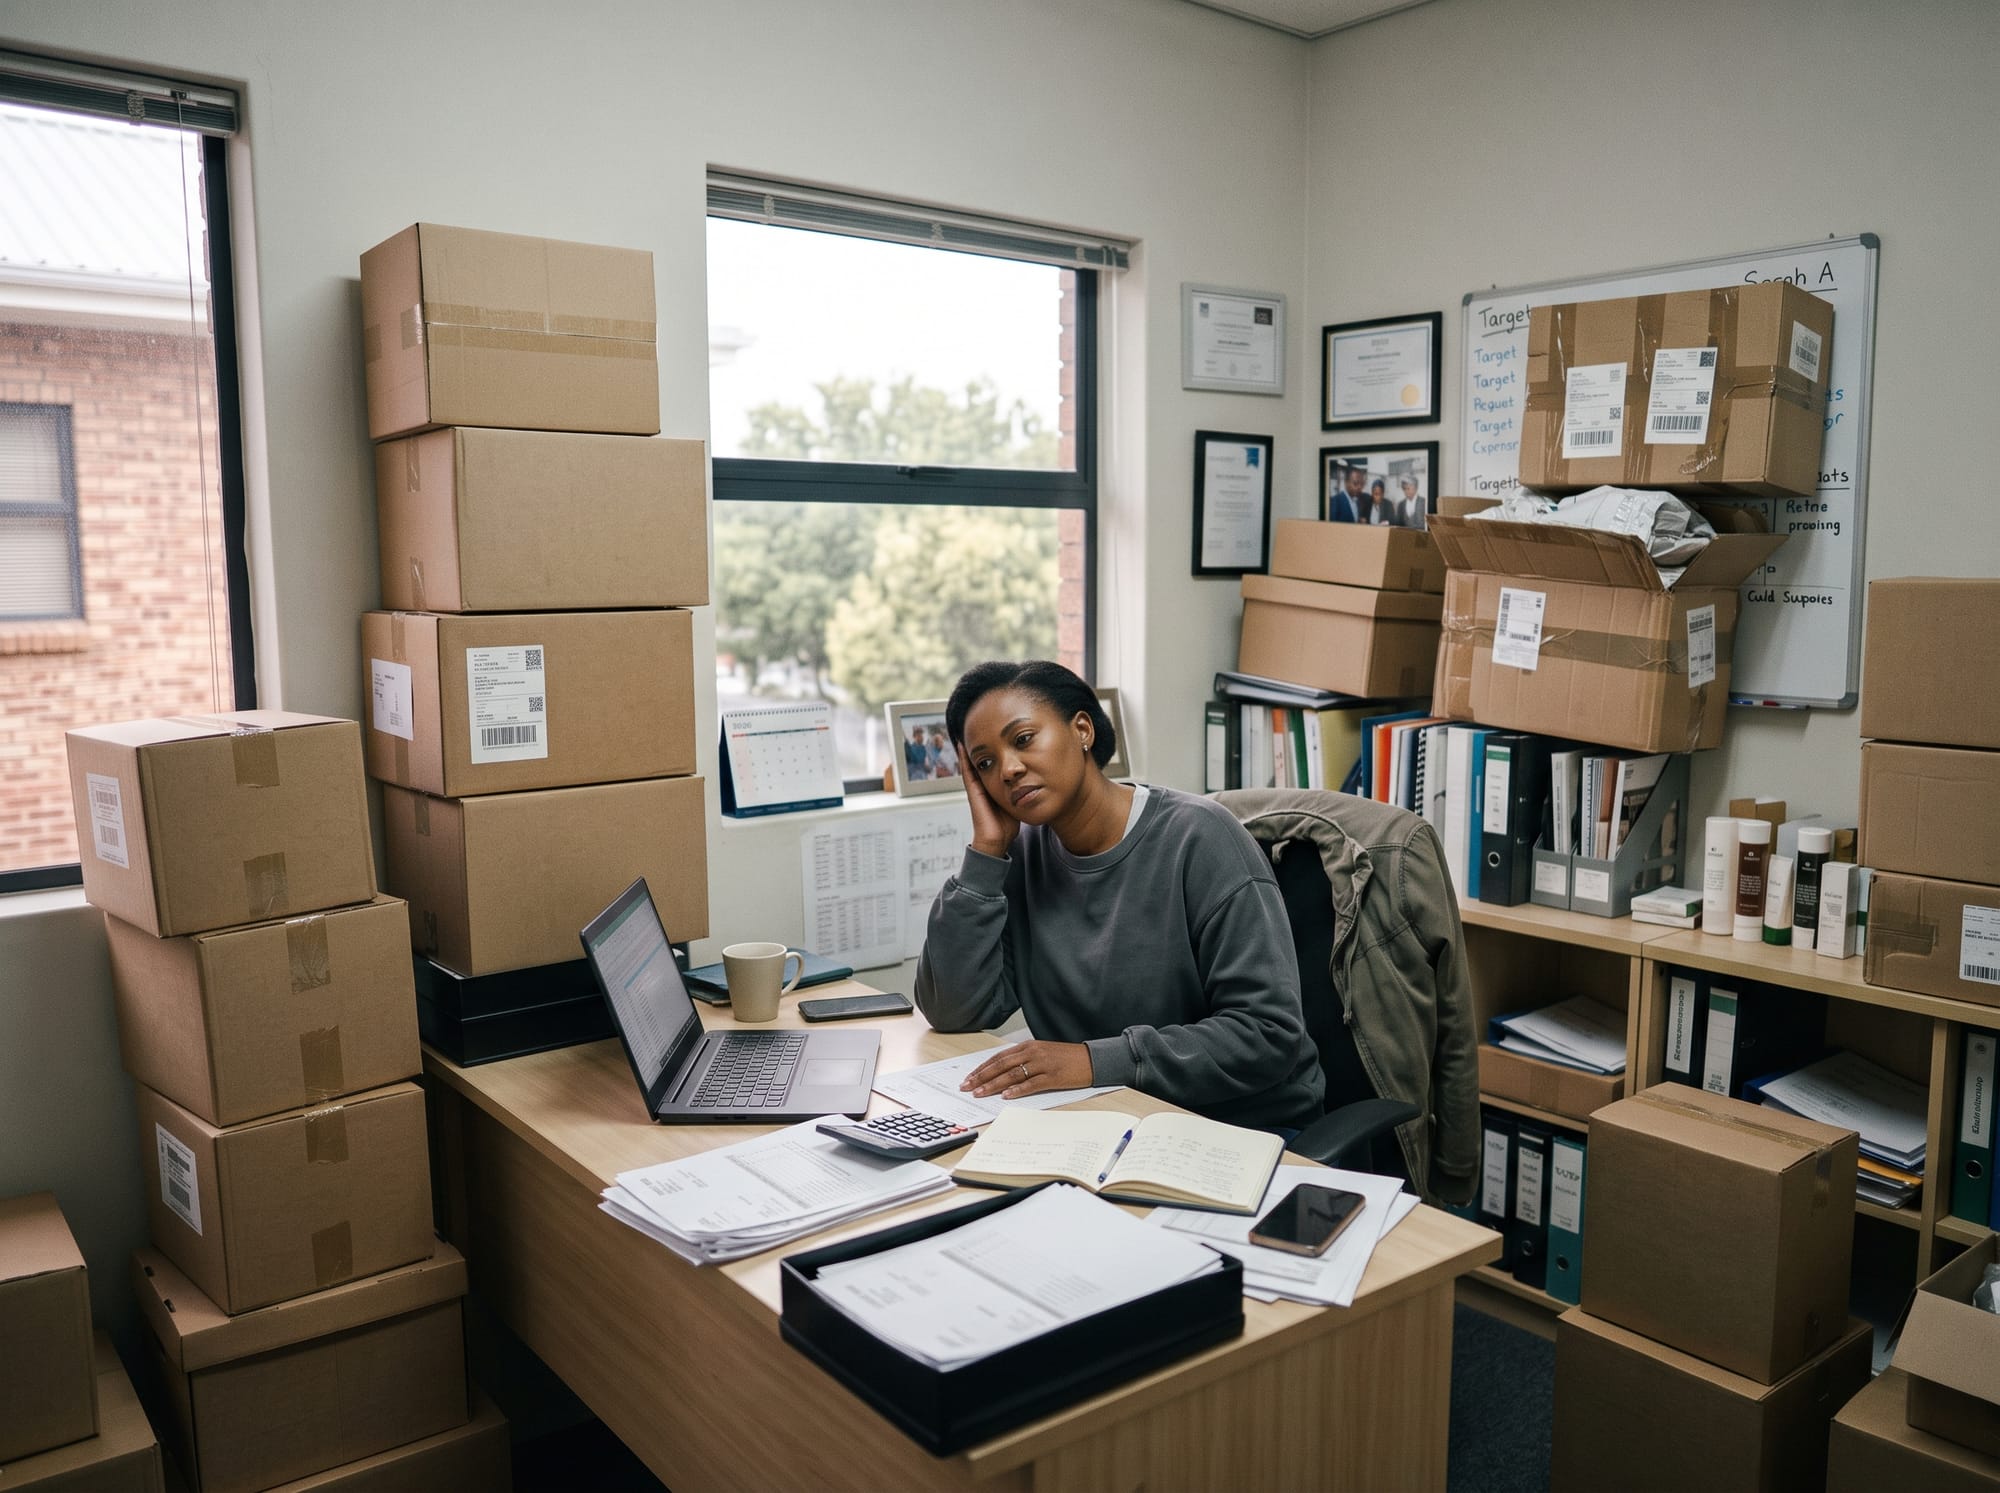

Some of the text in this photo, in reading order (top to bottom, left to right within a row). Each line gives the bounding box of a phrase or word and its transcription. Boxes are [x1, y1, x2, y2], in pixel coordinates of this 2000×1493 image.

[1819, 261, 1834, 284] A
[1478, 304, 1532, 334] Target
[1474, 345, 1517, 367] Target
[1473, 370, 1516, 392] Target
[1473, 417, 1513, 437] Target
